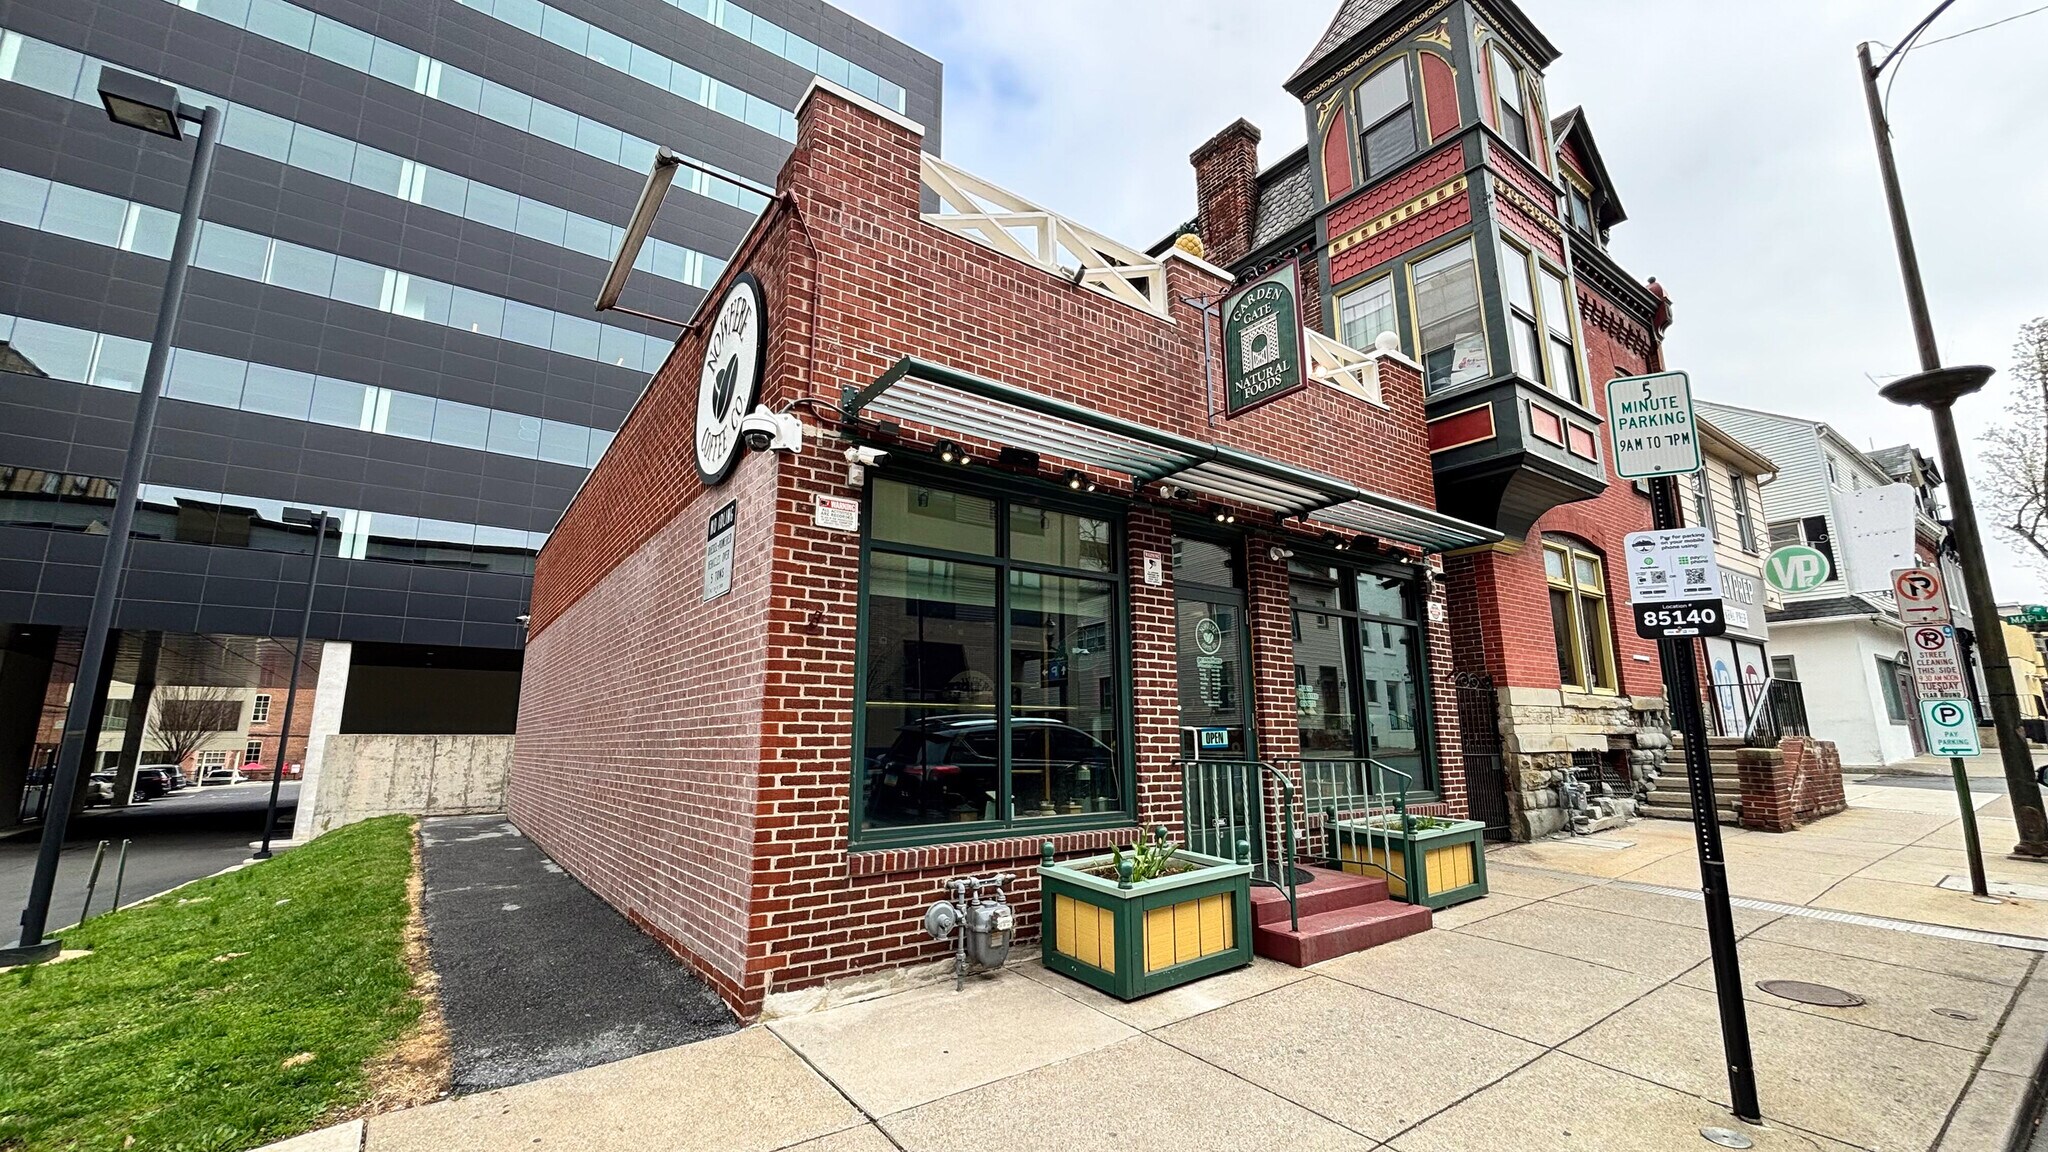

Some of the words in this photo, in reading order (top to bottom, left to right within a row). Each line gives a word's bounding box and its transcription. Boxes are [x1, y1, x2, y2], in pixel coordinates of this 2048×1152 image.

[1233, 287, 1282, 322] GARDEN
[1243, 302, 1272, 324] GATE
[707, 296, 752, 374] NOWHERE
[1235, 360, 1290, 393] NATURAL
[1244, 374, 1282, 399] FOODS
[1642, 383, 1652, 400] 5
[1621, 396, 1679, 414] MINUTE
[1619, 411, 1686, 430] PARKING
[701, 425, 727, 462] COFFEE
[1620, 438, 1643, 452] 9AM
[1647, 436, 1661, 449] TO
[1665, 432, 1690, 446] 7PM
[709, 517, 718, 535] NO
[1771, 554, 1819, 588] VP
[1643, 609, 1716, 626] 85140
[1921, 682, 1960, 690] TUESDAY
[1205, 732, 1224, 744] OPEN
